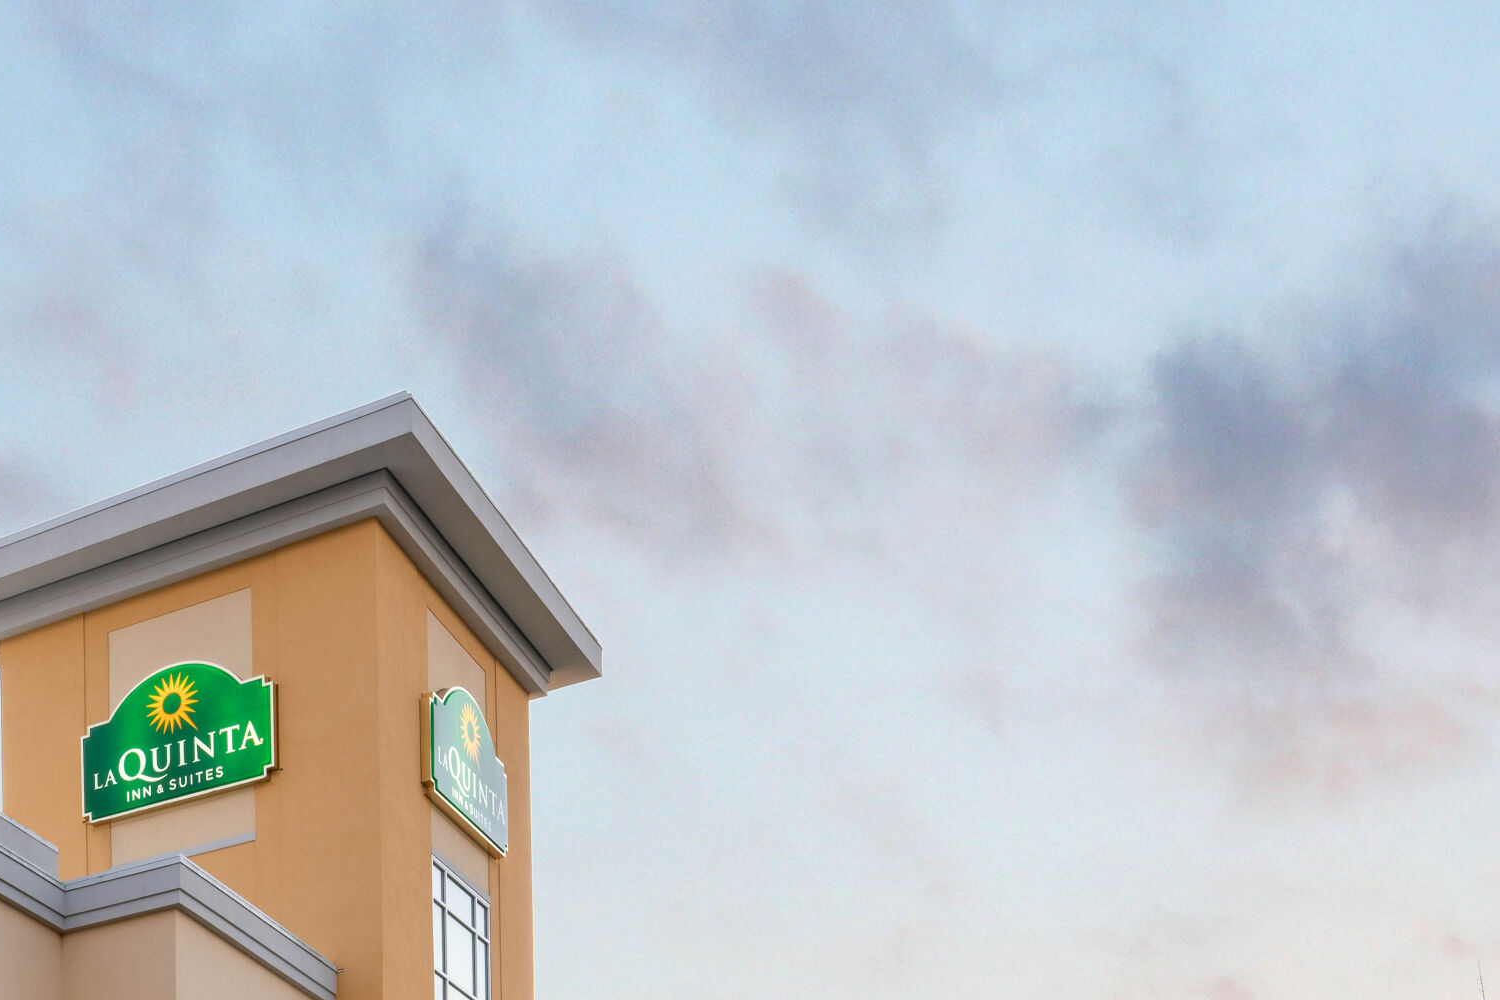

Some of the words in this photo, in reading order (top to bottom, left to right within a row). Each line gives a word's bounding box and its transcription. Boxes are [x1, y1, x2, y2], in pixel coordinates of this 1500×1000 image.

[93, 769, 117, 790] LA
[118, 720, 264, 782] QUINTA
[127, 785, 152, 803] INN
[156, 784, 165, 794] &
[169, 766, 224, 791] SUITES
[449, 746, 506, 825] QUINTA
[451, 786, 464, 807] INN
[469, 804, 492, 832] SUITES
